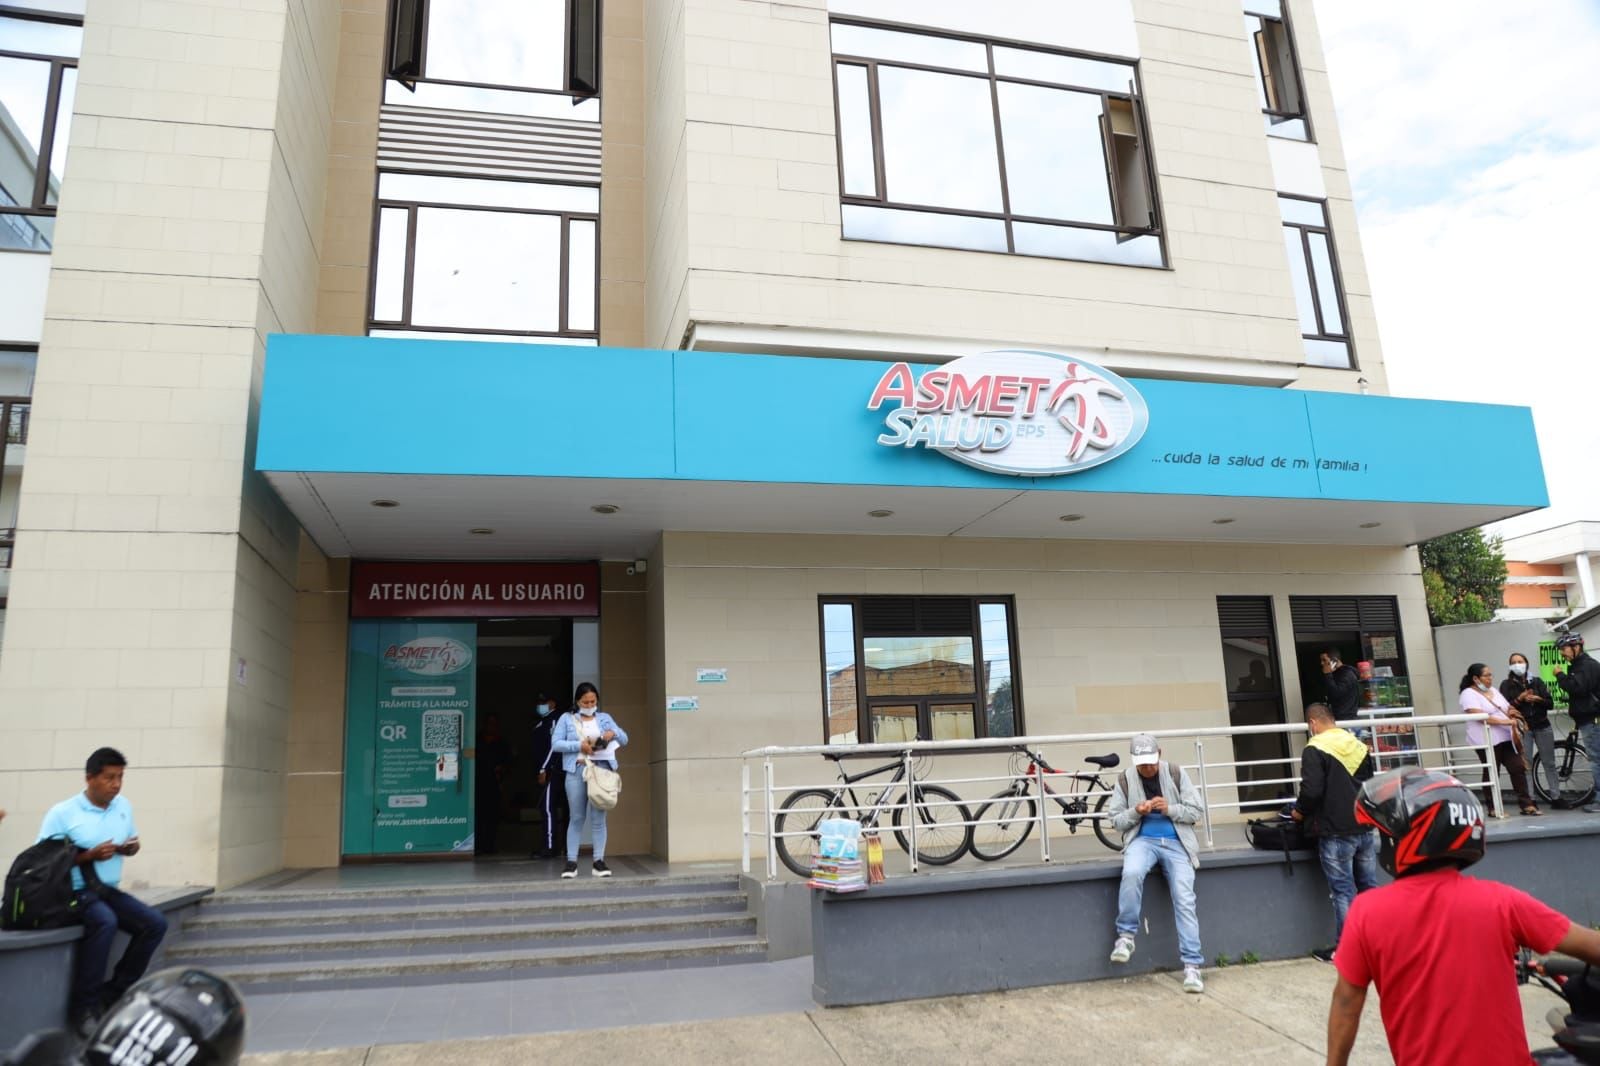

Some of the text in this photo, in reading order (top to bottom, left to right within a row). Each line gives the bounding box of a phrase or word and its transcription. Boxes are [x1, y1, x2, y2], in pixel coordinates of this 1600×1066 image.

[867, 362, 1051, 418] ASMET
[877, 408, 1047, 453] SALUD EPS
[1207, 453, 1221, 466] la
[1227, 454, 1265, 468] salud
[1270, 455, 1287, 468] de
[1292, 458, 1310, 470] mi
[1315, 456, 1360, 472] familia
[369, 580, 586, 601] ATENCIÓN AL USUARIO
[383, 644, 441, 660] ASMET
[379, 698, 469, 709] TRÁMITES A LA MANO
[380, 725, 407, 742] QR
[377, 816, 467, 827] www.asmetsalud.com
